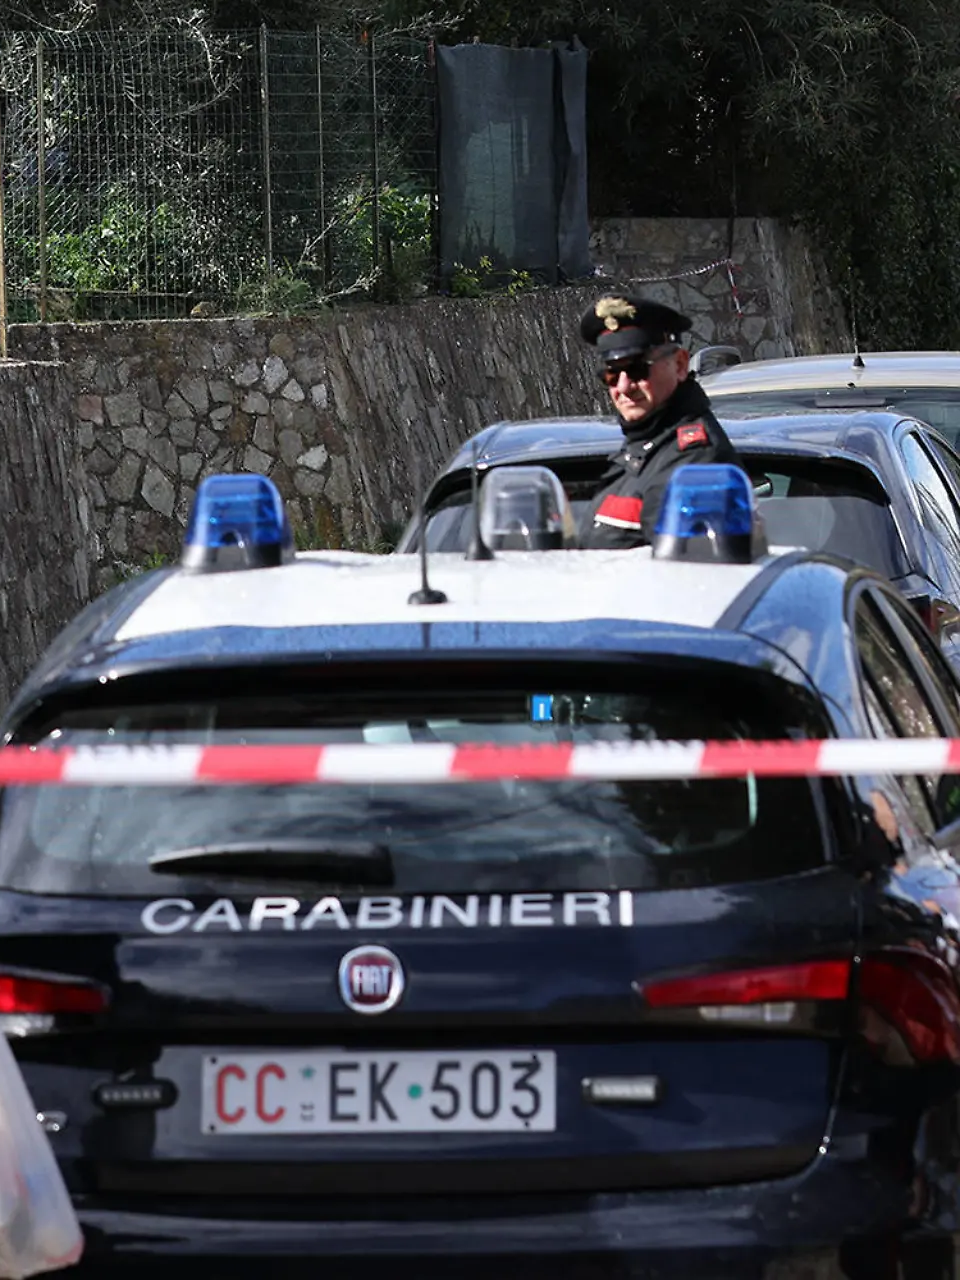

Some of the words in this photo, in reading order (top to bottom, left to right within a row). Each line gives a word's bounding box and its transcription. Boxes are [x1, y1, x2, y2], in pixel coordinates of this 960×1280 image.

[141, 891, 634, 934] CARABINIERI
[352, 964, 391, 996] FIAT
[215, 1062, 286, 1124] CC
[329, 1062, 399, 1122] EK
[429, 1060, 542, 1121] 503
